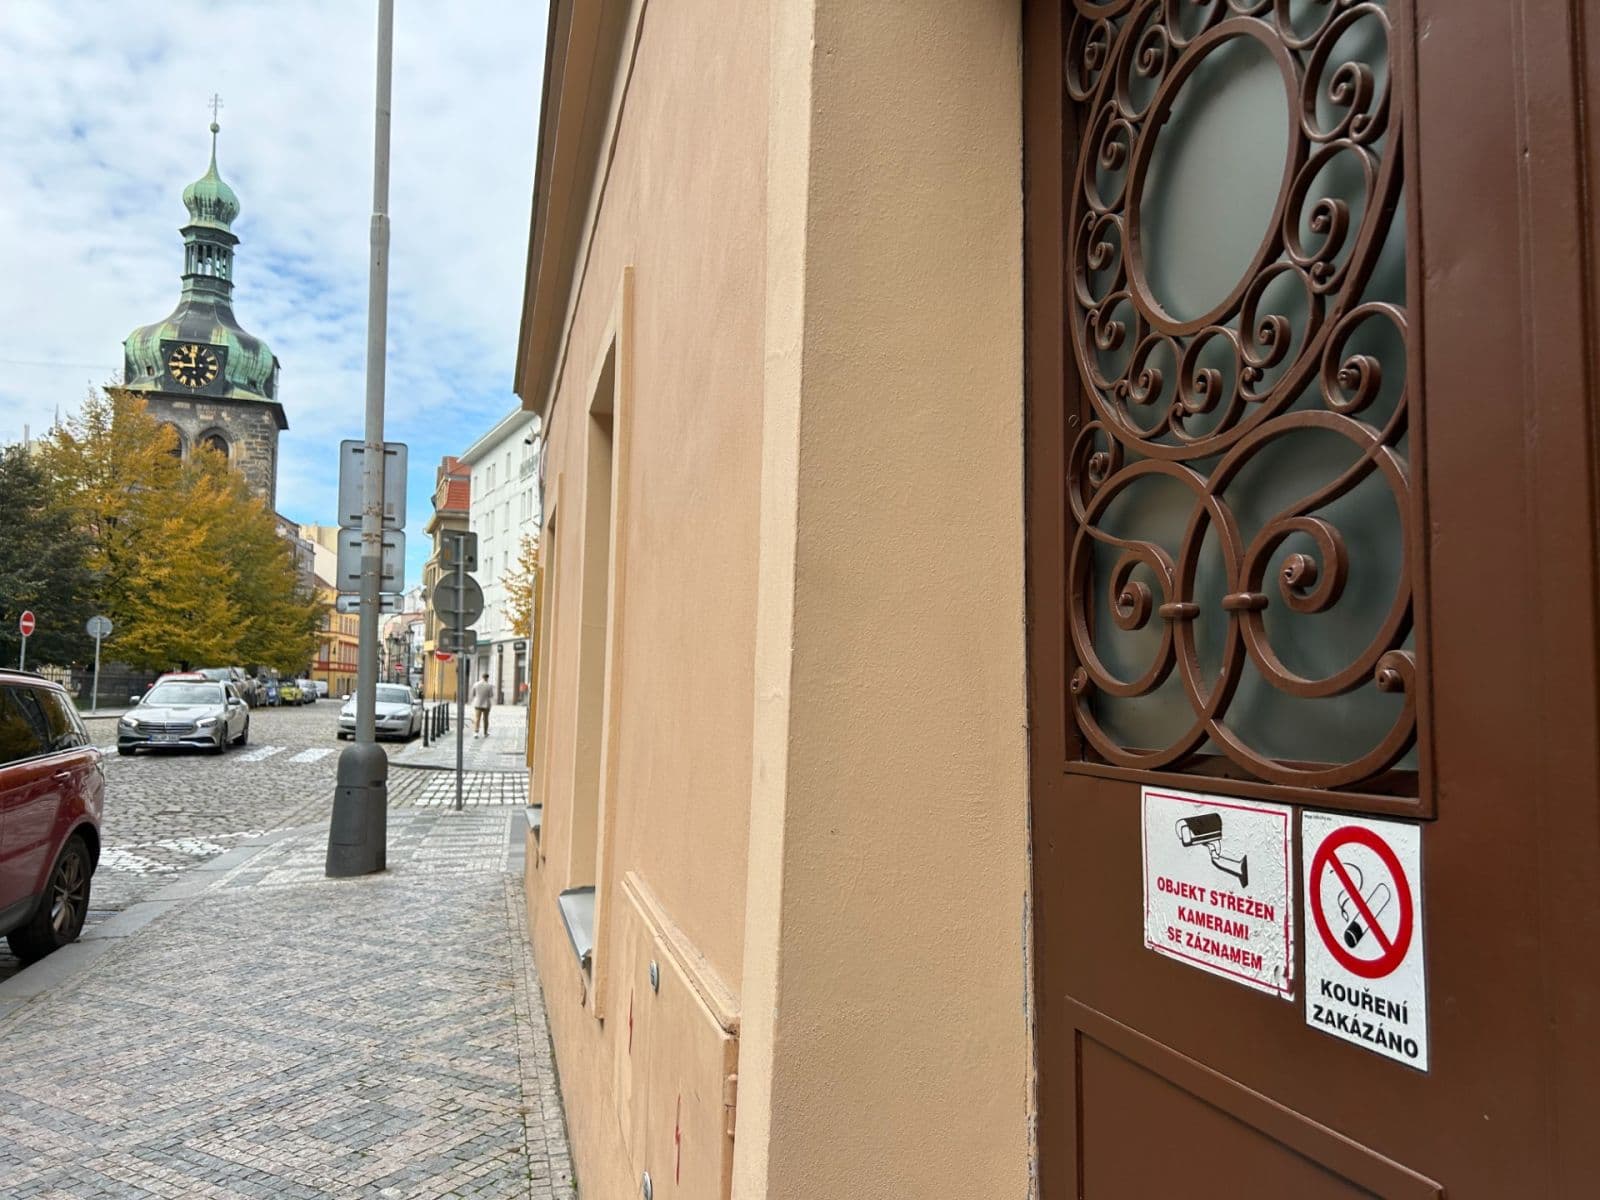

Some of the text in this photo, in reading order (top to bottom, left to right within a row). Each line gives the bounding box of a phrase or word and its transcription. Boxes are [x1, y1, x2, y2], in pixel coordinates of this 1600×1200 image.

[1157, 877, 1274, 921] OBJEKT STŘEŽEN
[1178, 906, 1249, 940] KAMERAMI
[1167, 926, 1262, 971] SE ZÁZNAMEM
[1321, 979, 1408, 1024] KOUŘENÍ
[1313, 1004, 1418, 1058] ZAKÁZÁNO
